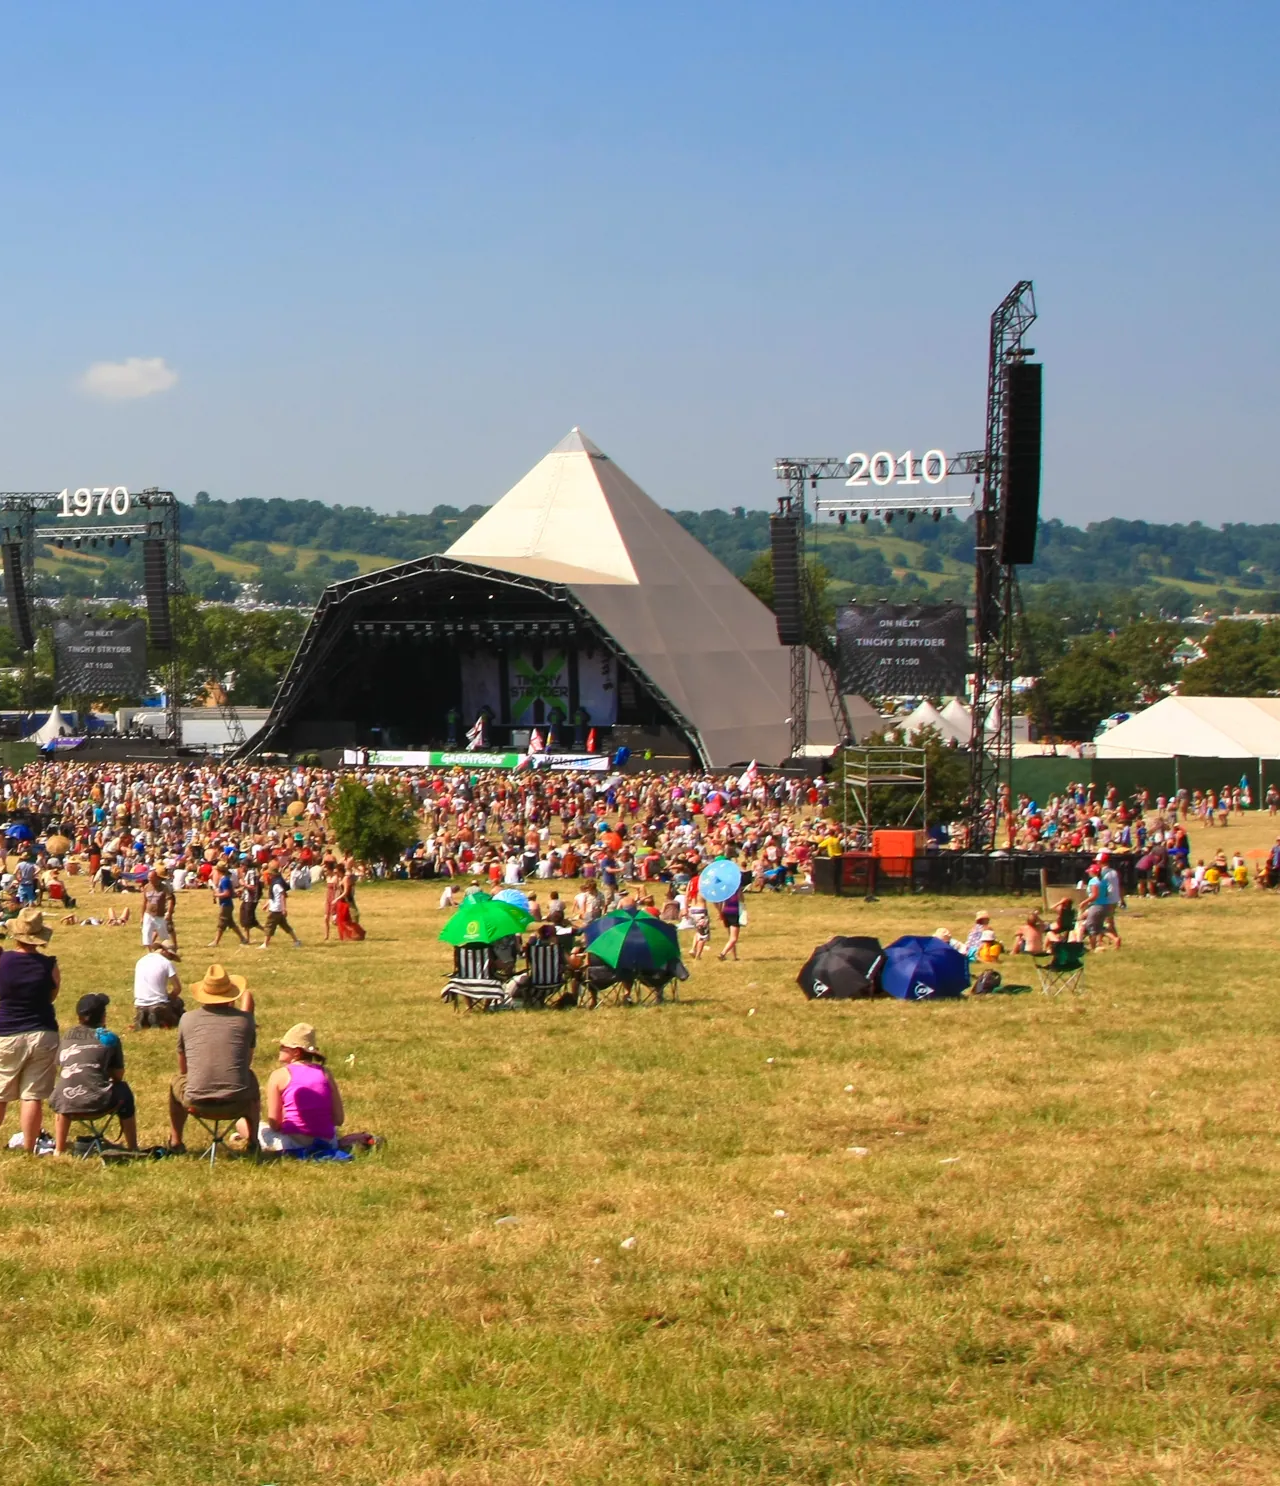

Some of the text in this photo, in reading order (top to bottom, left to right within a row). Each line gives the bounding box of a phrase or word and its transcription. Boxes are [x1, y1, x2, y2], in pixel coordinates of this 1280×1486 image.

[844, 449, 946, 487] 2010
[56, 486, 130, 517] 1970
[856, 638, 945, 646] TINCHY STRYDER
[97, 645, 132, 653] STRYDER
[441, 753, 506, 765] GREENPEACE
